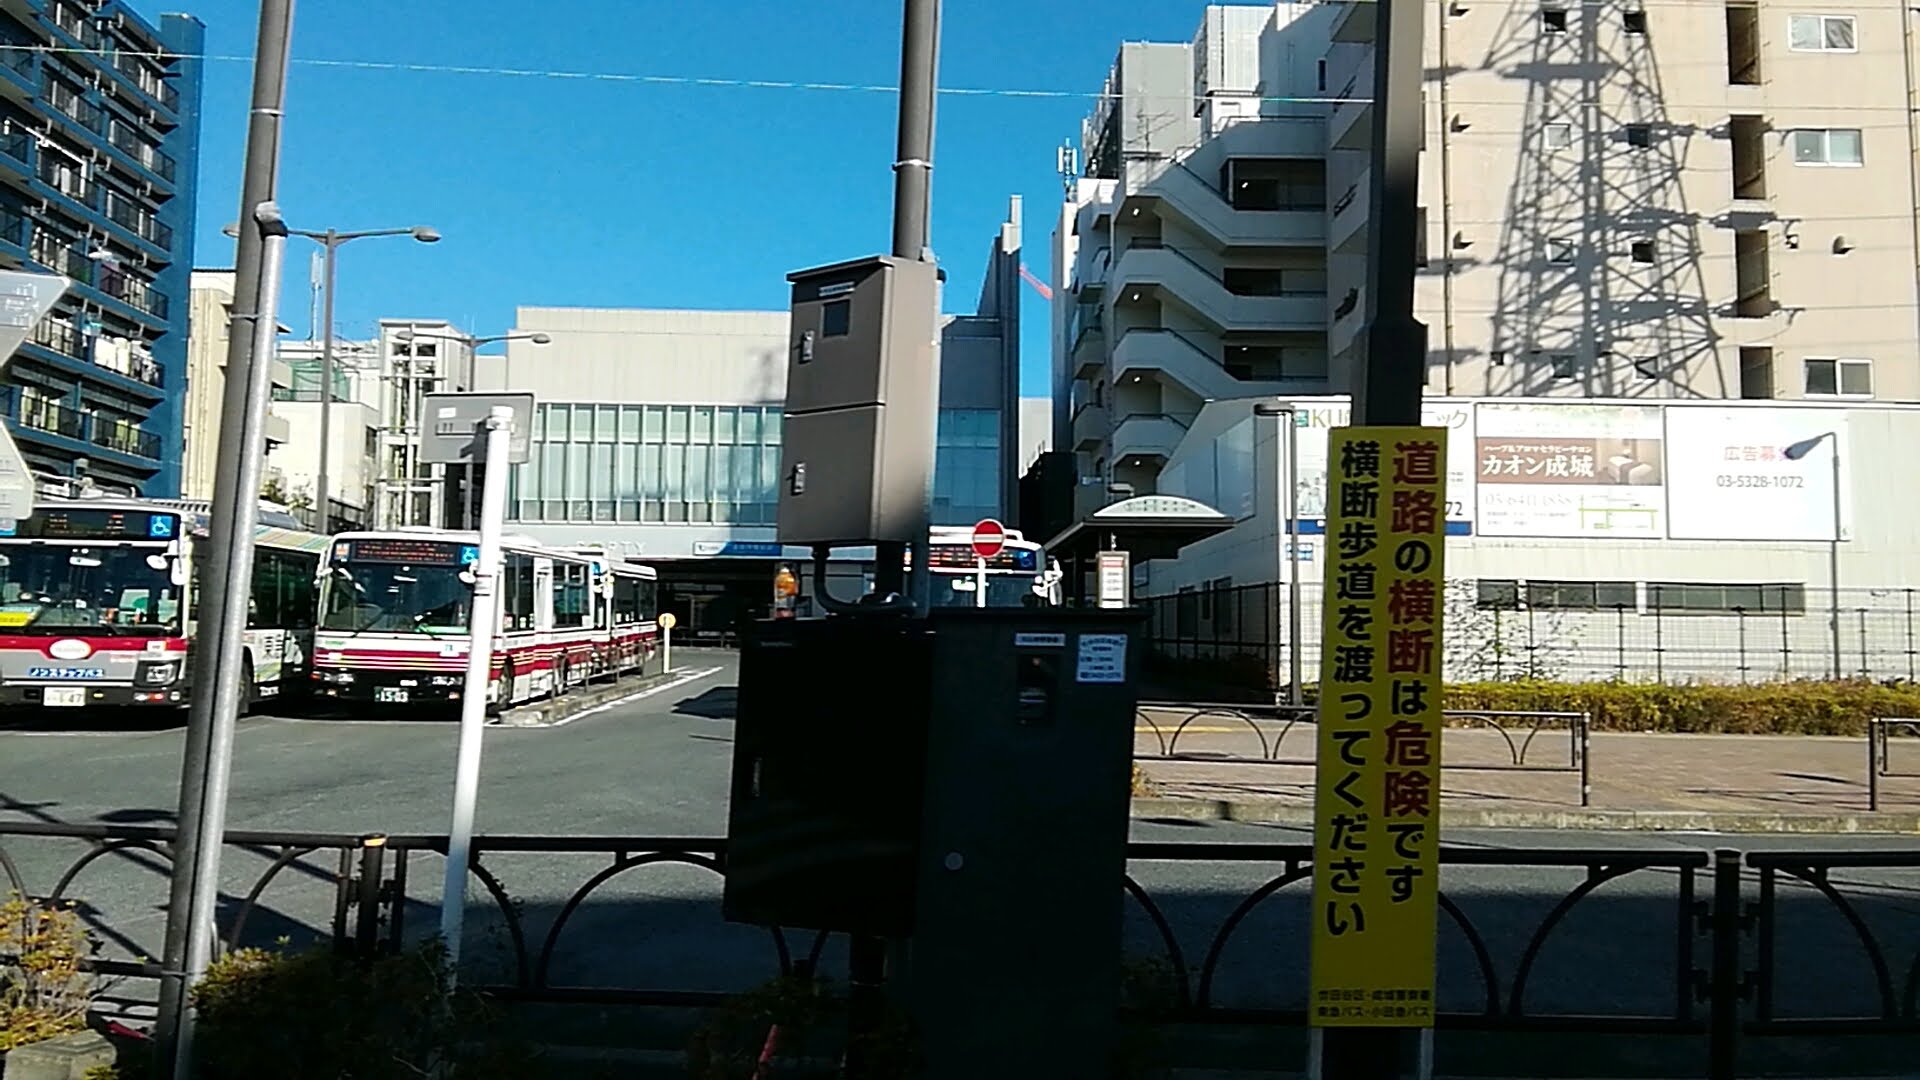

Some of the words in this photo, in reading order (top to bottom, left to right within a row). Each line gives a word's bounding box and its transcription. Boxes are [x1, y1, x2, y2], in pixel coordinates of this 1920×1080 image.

[1481, 454, 1596, 479] カオン成城
[1716, 474, 1805, 489] 03-5328-1072
[30, 668, 104, 678] ノンステップバス
[1383, 440, 1440, 903] 道路の横断は危険です
[1326, 440, 1381, 937] 横断歩道を渡ってください
